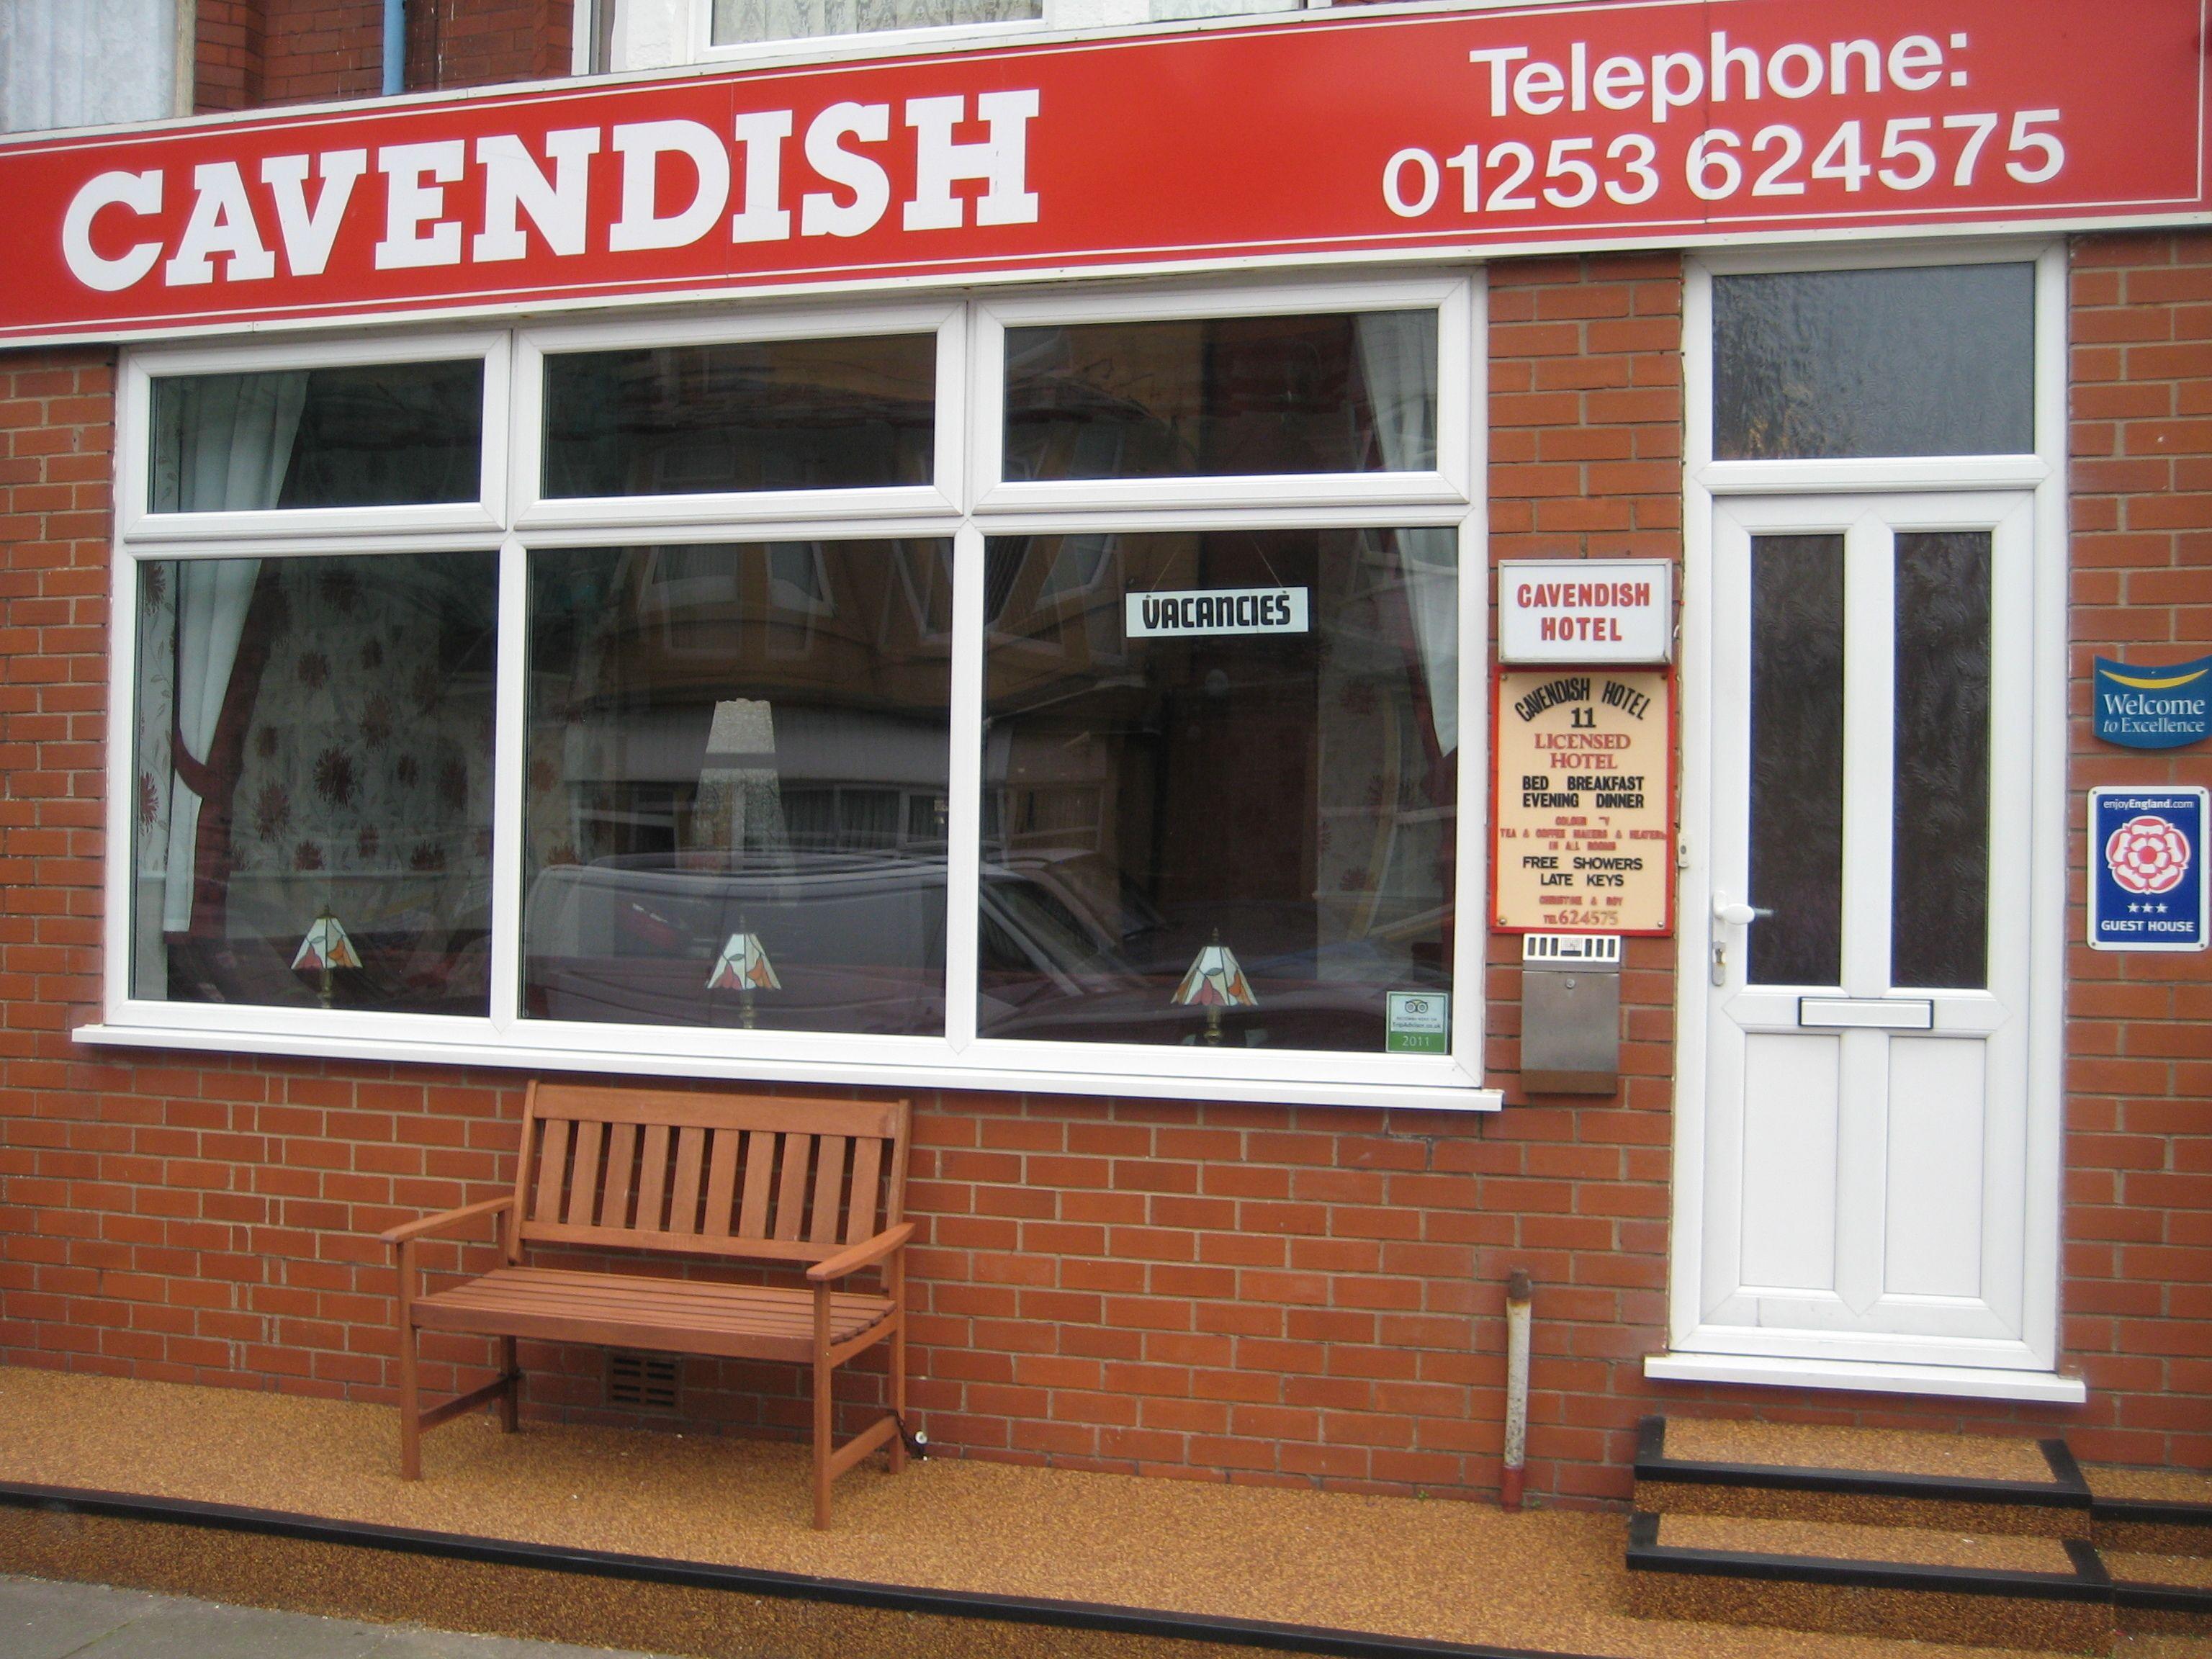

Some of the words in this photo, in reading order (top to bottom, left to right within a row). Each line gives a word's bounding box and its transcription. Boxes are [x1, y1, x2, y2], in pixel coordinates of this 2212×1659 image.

[1469, 31, 1968, 123] Telephone:
[1381, 133, 1660, 218] 01253
[1685, 109, 2065, 202] 624575
[61, 89, 1040, 292] CAVENDISH
[1516, 583, 1650, 608] CAVENDISH
[1142, 595, 1291, 629] VACANCIES
[1541, 616, 1622, 641] HOTEL
[1514, 678, 1591, 722] CAVENDISH
[1601, 680, 1651, 721] HOTEL
[2103, 693, 2206, 715] Welcome
[1570, 707, 1596, 728] 11
[2103, 719, 2118, 732] to
[2121, 717, 2206, 733] Excellence
[1534, 733, 1632, 750] LICENSED
[1550, 752, 1618, 769] HOTEL
[1522, 775, 1549, 791] BED
[1566, 776, 1645, 791] BREAKFAST
[1522, 793, 1579, 808] EVENING
[1596, 793, 1645, 809] DINNER
[2103, 799, 2195, 810] enjoyEngland.com
[1565, 841, 1581, 850] AL
[1522, 856, 1558, 869] FREE
[1573, 857, 1643, 871] SHOWERS
[1540, 873, 1573, 886] LATE
[1586, 874, 1624, 886] KEYS
[1558, 909, 1619, 925] 624575
[2101, 920, 2144, 932] GUEST
[2148, 921, 2195, 932] HOUSE
[1402, 1035, 1430, 1047] 2011
